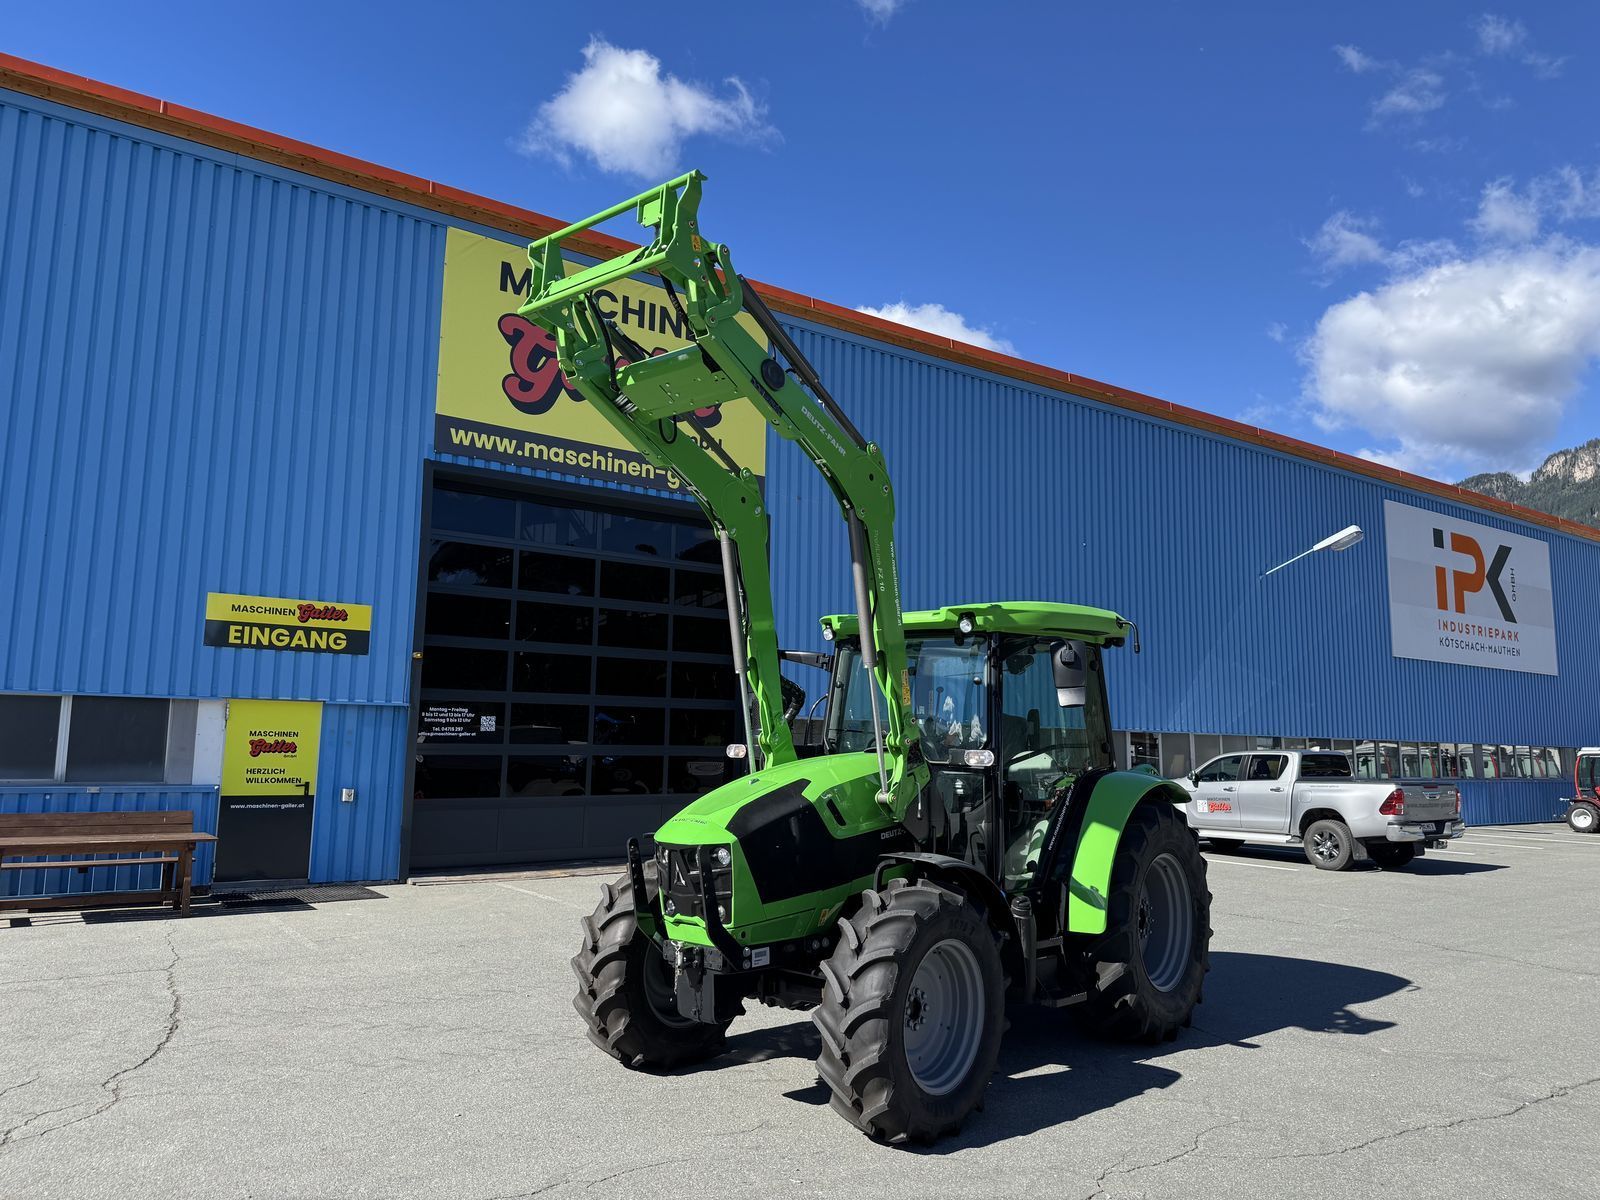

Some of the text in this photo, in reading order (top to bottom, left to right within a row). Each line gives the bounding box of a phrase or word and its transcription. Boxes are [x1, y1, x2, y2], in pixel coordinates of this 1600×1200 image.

[500, 261, 699, 343] MCHIN
[801, 406, 846, 457] DEUTZ-FAHR
[450, 427, 682, 489] www.maschinen-g
[231, 603, 348, 623] MASCHINEN Gailer
[228, 625, 347, 650] EINGANG
[1438, 619, 1520, 642] INDUSTRIEPARK
[249, 730, 299, 738] MASCHINEN
[249, 738, 297, 757] Gailer
[230, 802, 305, 810] www.maschinen-gailer.at
